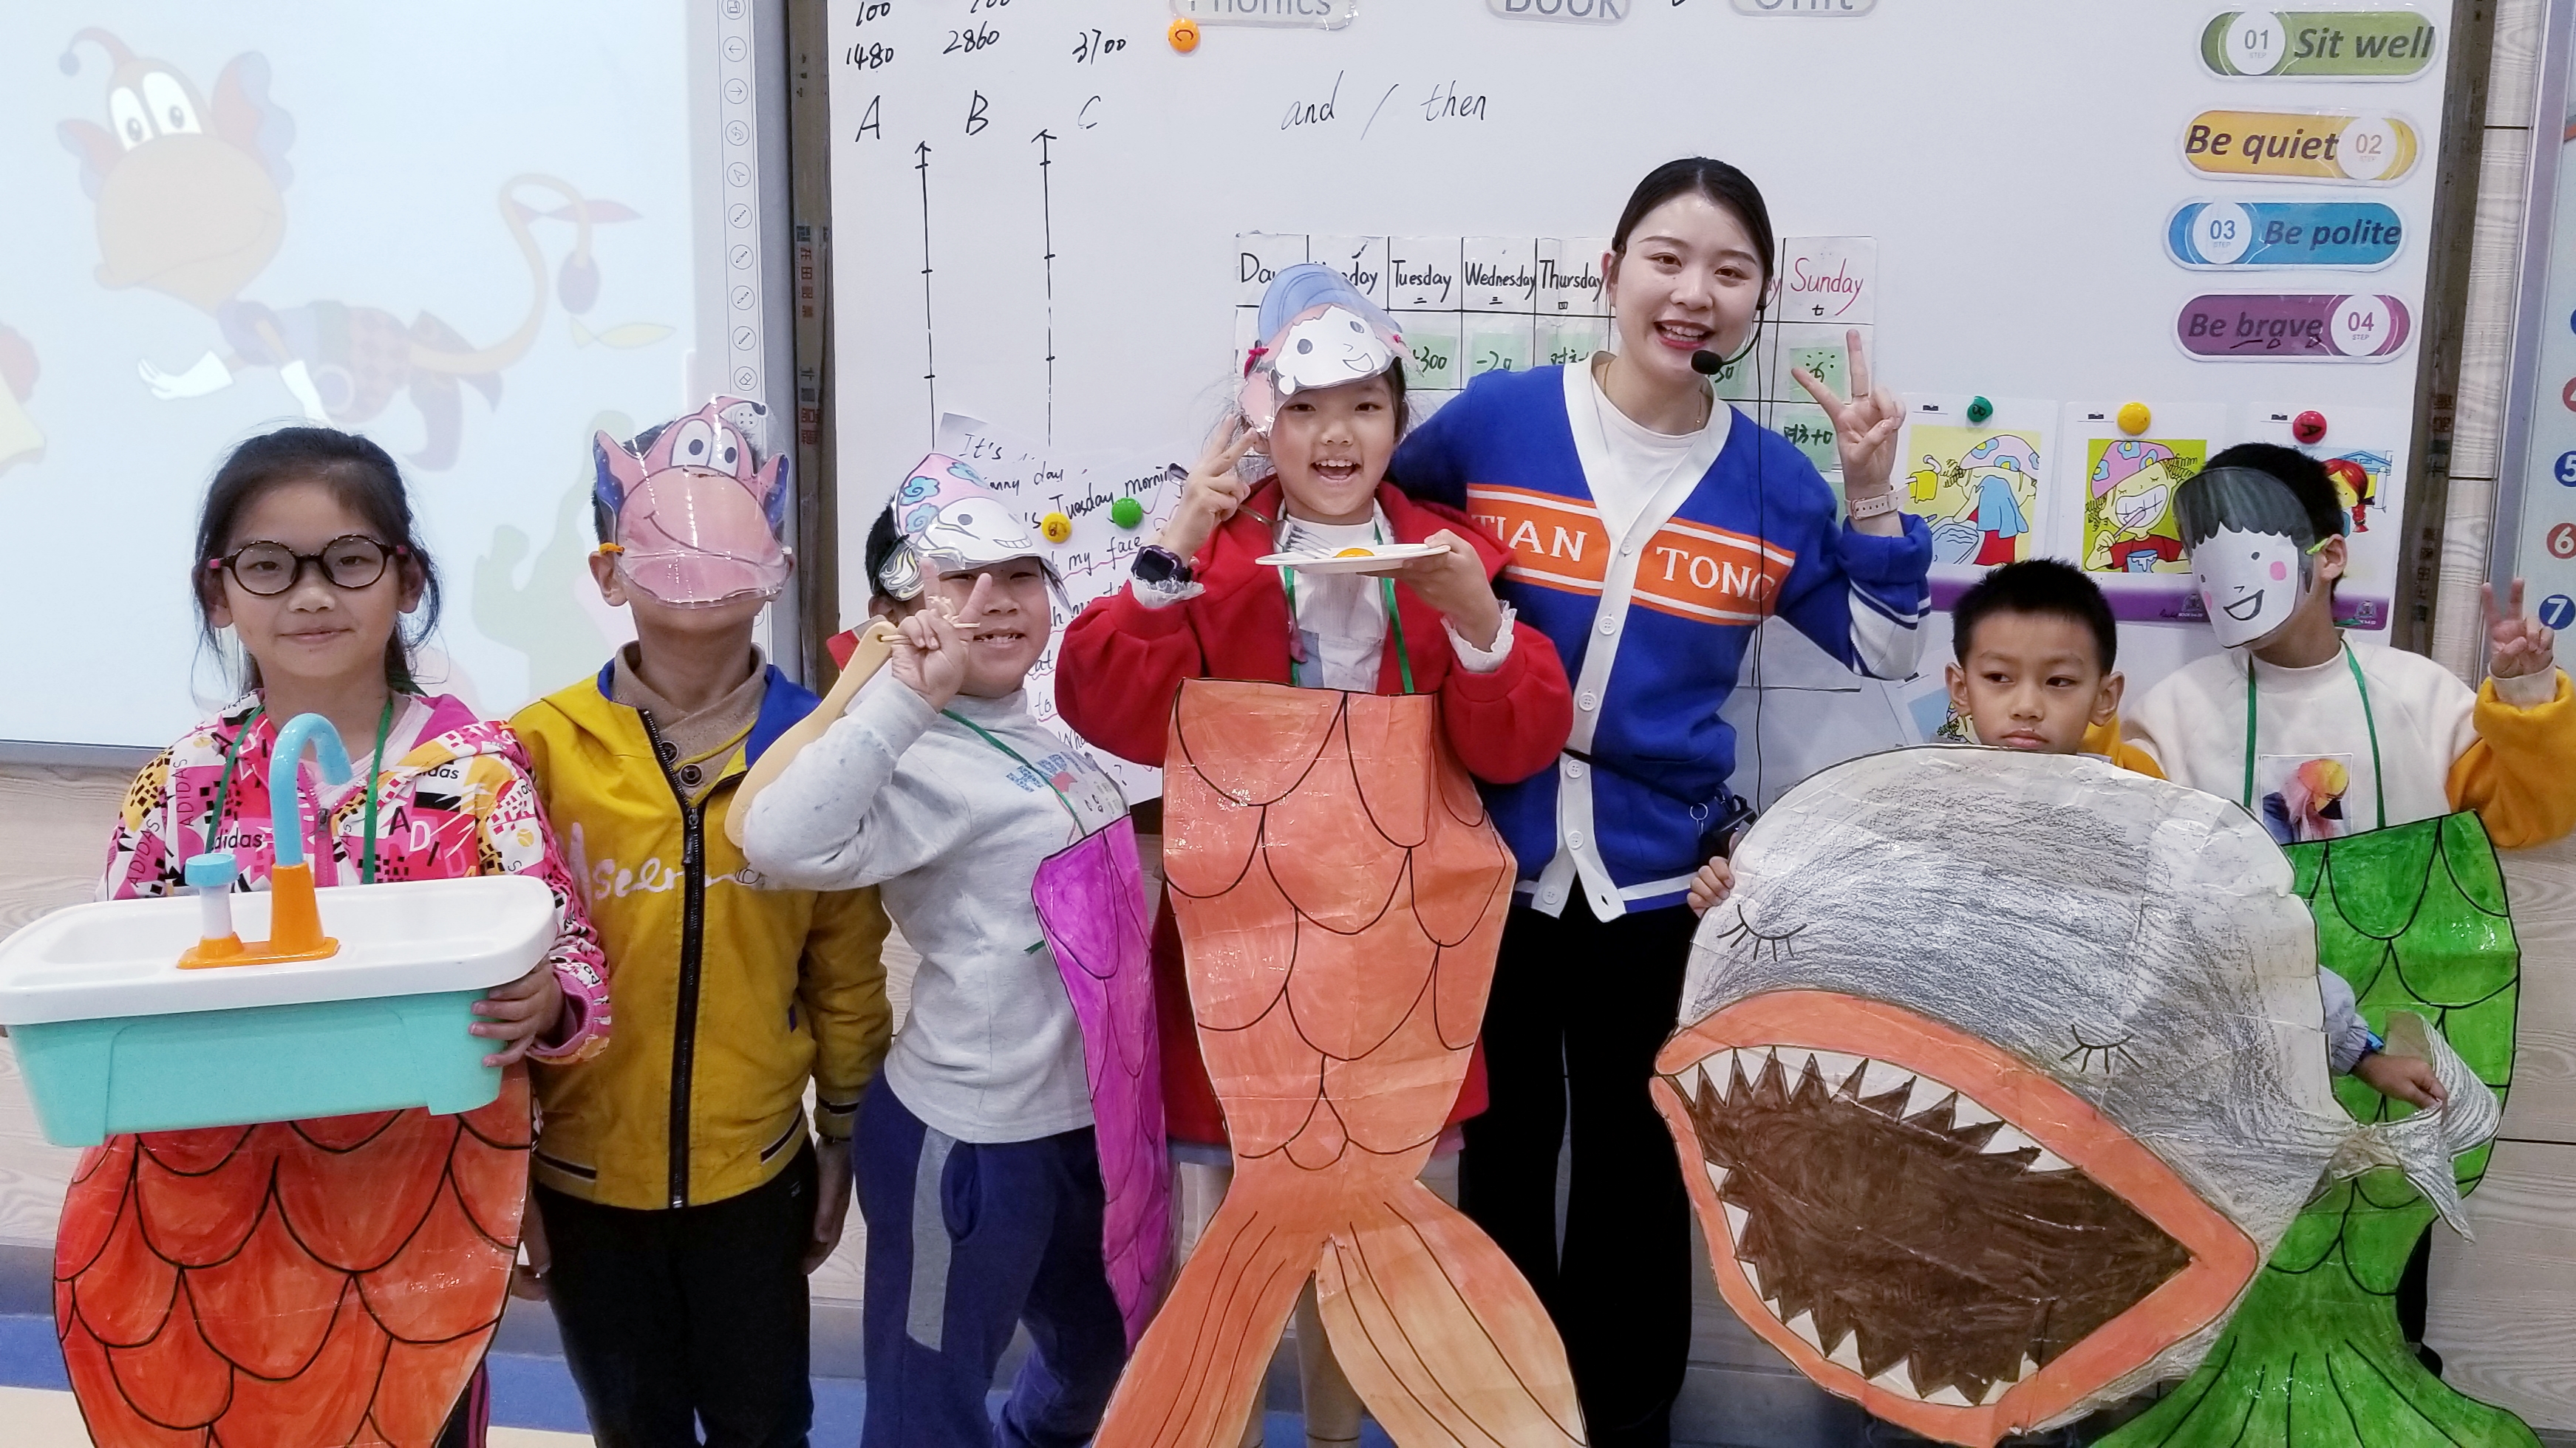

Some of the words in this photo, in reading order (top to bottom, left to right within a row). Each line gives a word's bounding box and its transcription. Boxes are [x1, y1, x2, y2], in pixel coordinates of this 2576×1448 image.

[943, 21, 1000, 55] 2860
[1072, 29, 1126, 65] 3700
[2244, 30, 2269, 49] 01
[2294, 27, 2343, 58] Sit
[2355, 26, 2435, 58] well
[846, 42, 894, 70] 1480
[855, 95, 881, 142] A
[966, 89, 989, 135] B
[1077, 96, 1101, 129] C
[1281, 71, 1343, 131] and
[1420, 80, 1487, 122] then
[2185, 125, 2232, 155] Be
[2242, 129, 2340, 164] quiet
[2355, 134, 2382, 155] 02
[2209, 220, 2236, 240] 03
[2264, 221, 2303, 245] Be
[2310, 219, 2402, 250] polite
[1391, 260, 1452, 303] Tuesday
[1465, 261, 1536, 301] Wednesday
[1539, 259, 1605, 302] Thursday
[1790, 258, 1864, 316] Sunday
[2189, 313, 2226, 338] Be
[2237, 312, 2323, 338] brave
[2348, 313, 2374, 332] 04
[1034, 461, 1064, 486] day
[1048, 482, 1114, 523] Tuesday
[1125, 466, 1182, 499] morni
[2554, 526, 2575, 554] 6
[1069, 552, 1093, 577] my
[1106, 536, 1143, 570] face
[2547, 598, 2569, 625] 7
[171, 759, 194, 827] ADIDAS
[127, 819, 160, 888] ADIDAS
[211, 827, 263, 850] didas
